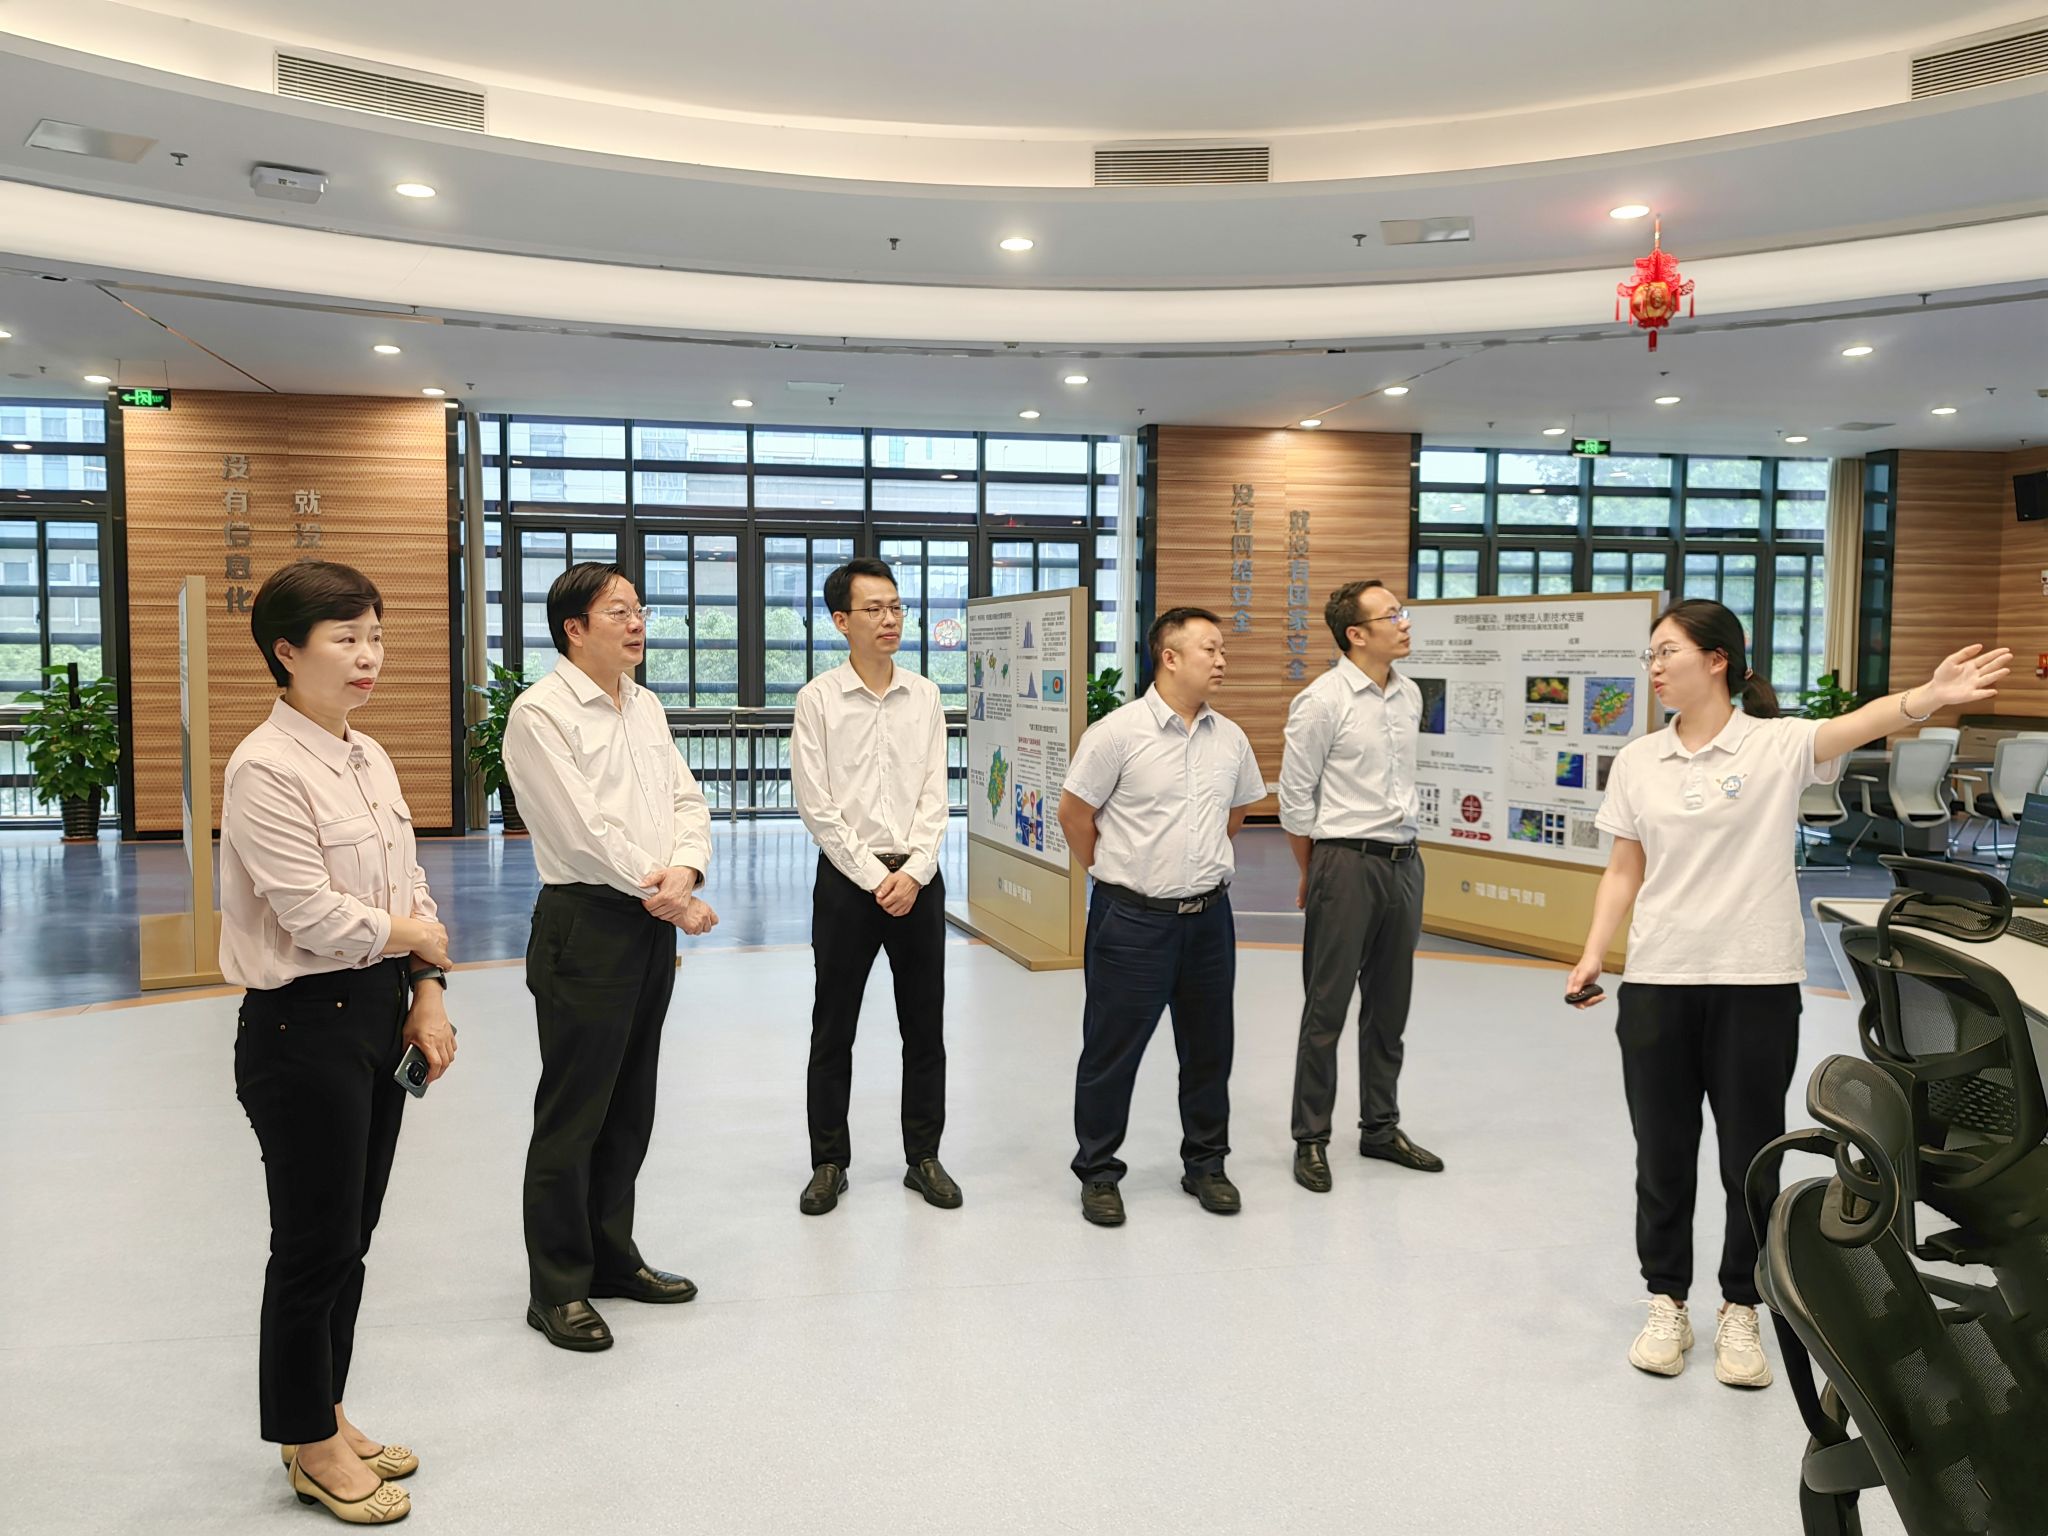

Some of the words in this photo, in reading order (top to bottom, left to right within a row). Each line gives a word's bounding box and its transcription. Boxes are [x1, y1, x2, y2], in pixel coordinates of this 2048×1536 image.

[223, 454, 252, 613] 没有信息化
[293, 489, 323, 562] 就没
[1232, 483, 1254, 632] 没有网络安全
[1288, 510, 1310, 680] 就没有国家安全
